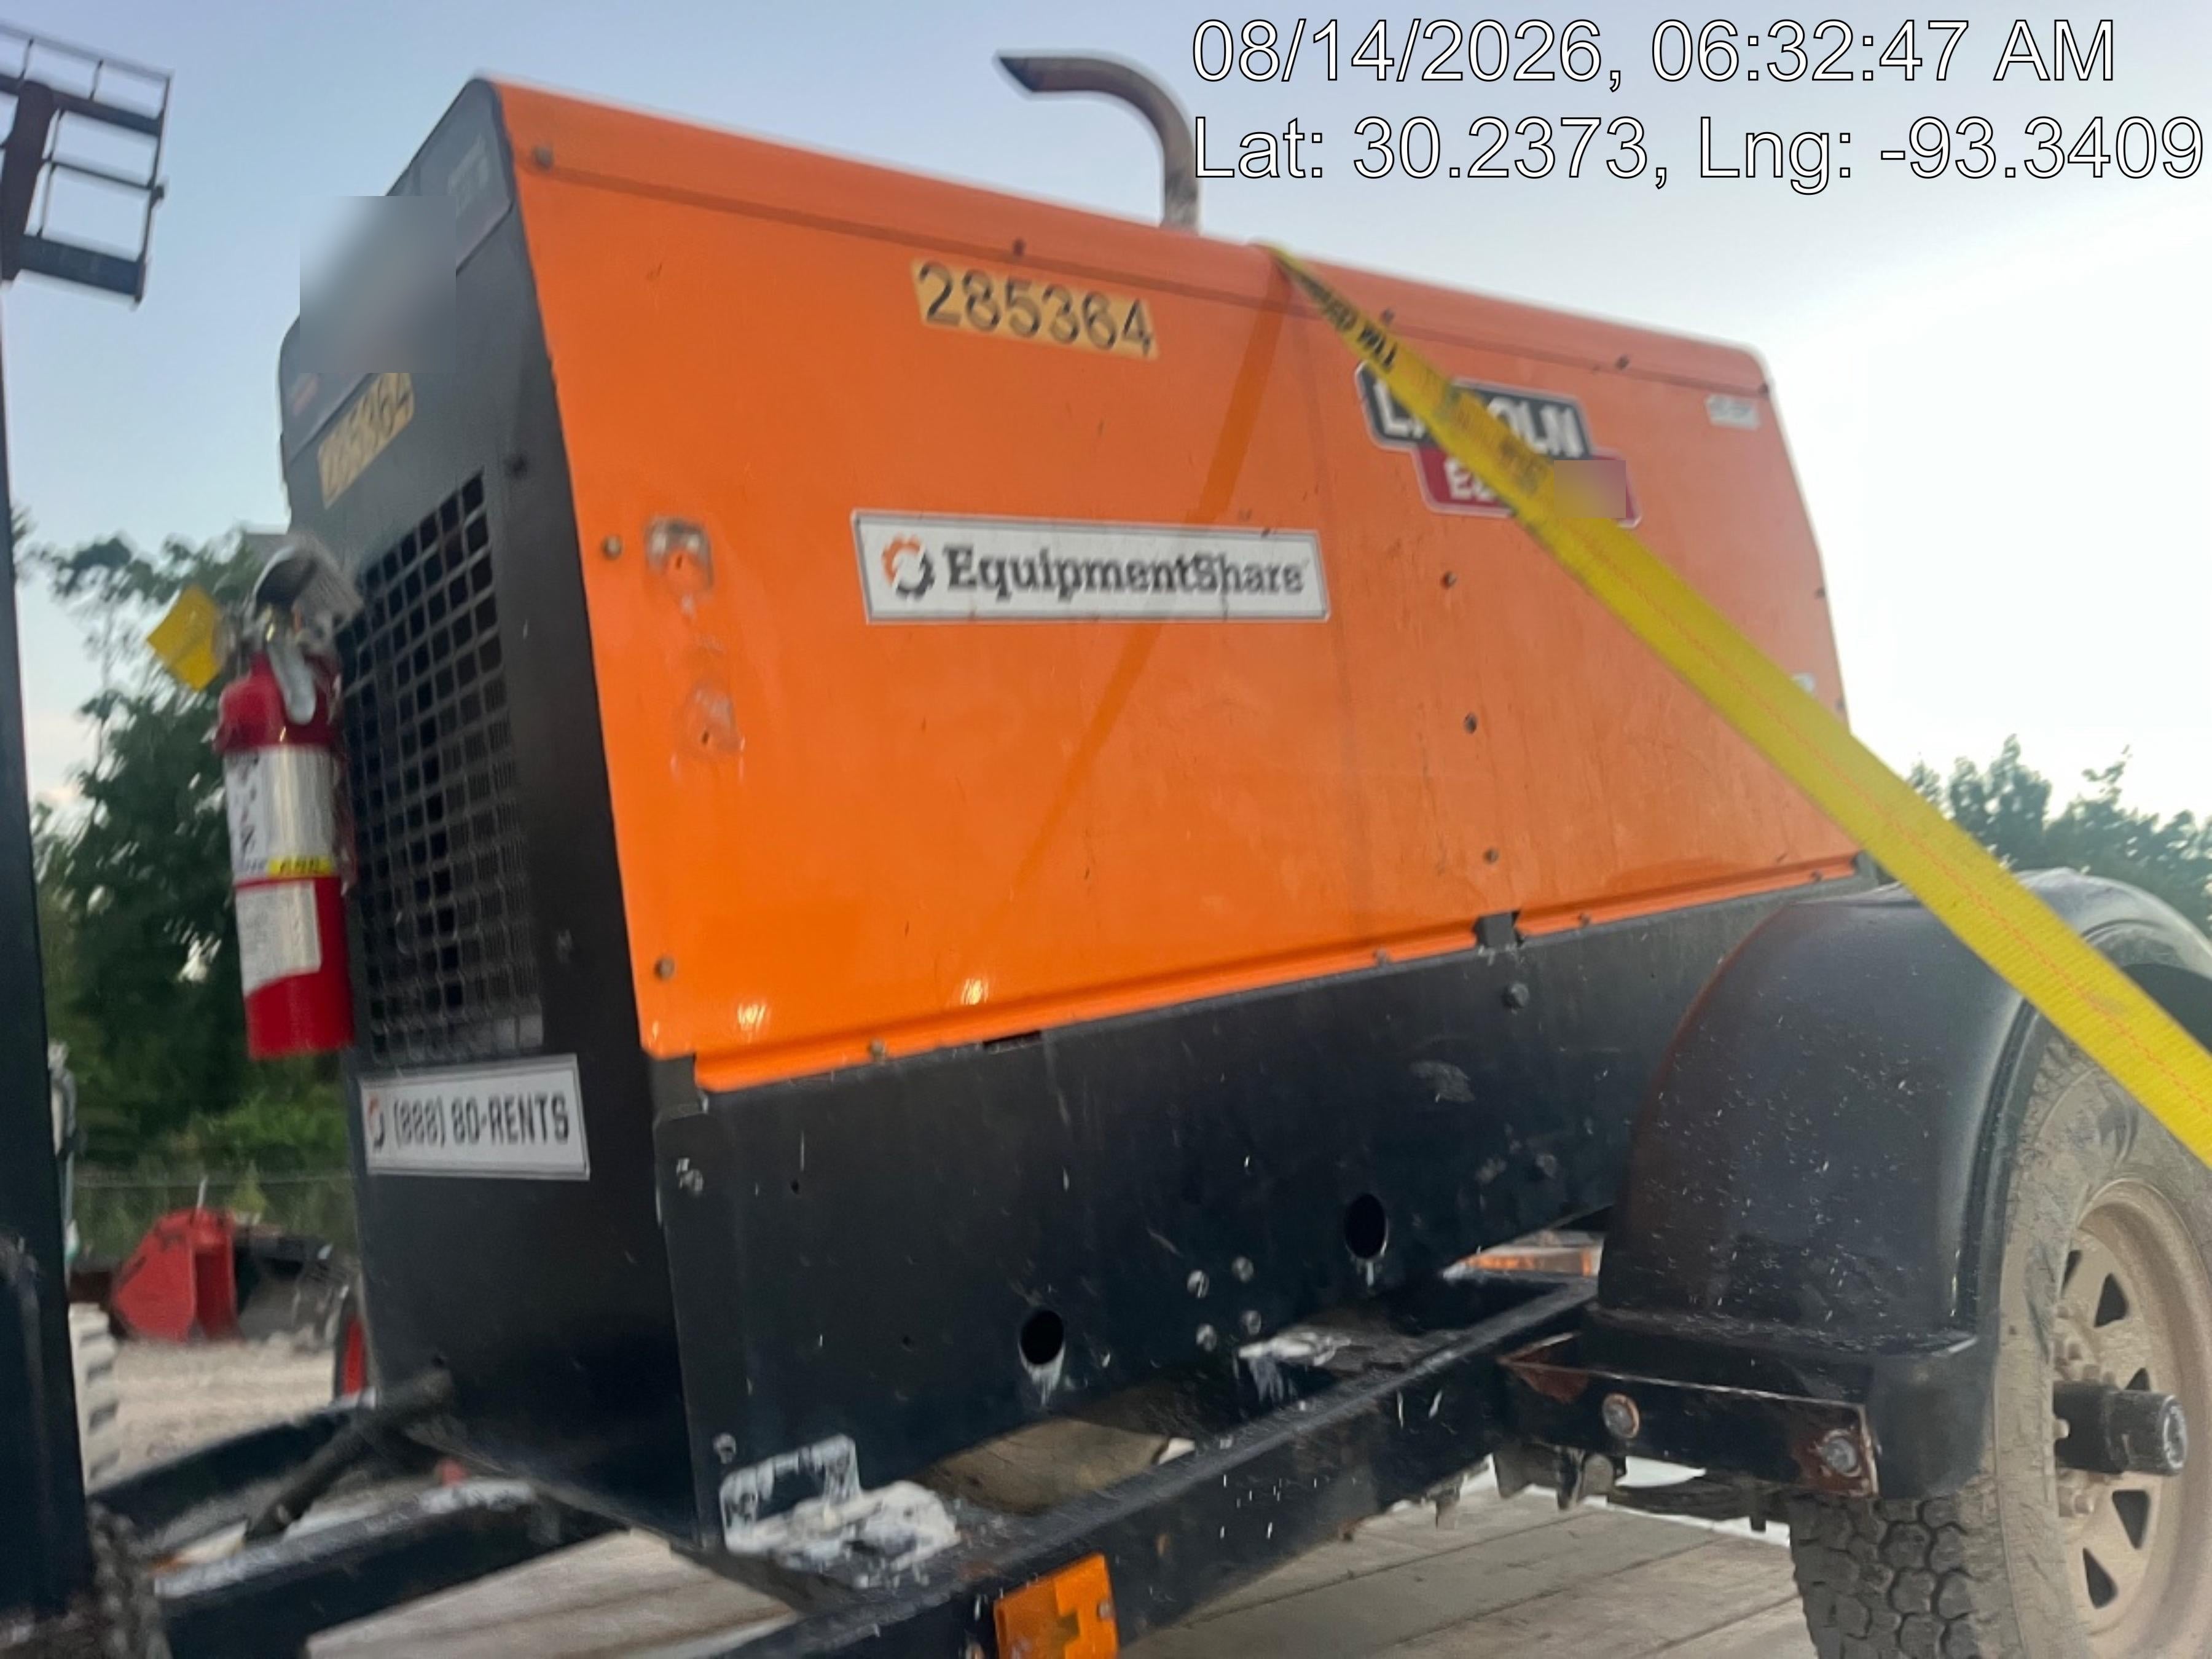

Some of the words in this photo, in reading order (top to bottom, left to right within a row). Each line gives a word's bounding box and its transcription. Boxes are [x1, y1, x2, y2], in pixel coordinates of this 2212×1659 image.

[918, 261, 1153, 356] 285364
[1375, 380, 1583, 458] LOLN
[943, 543, 1306, 601] EquipmentShare
[394, 1096, 446, 1149] (888)
[452, 1091, 570, 1145] 80-RENTS
